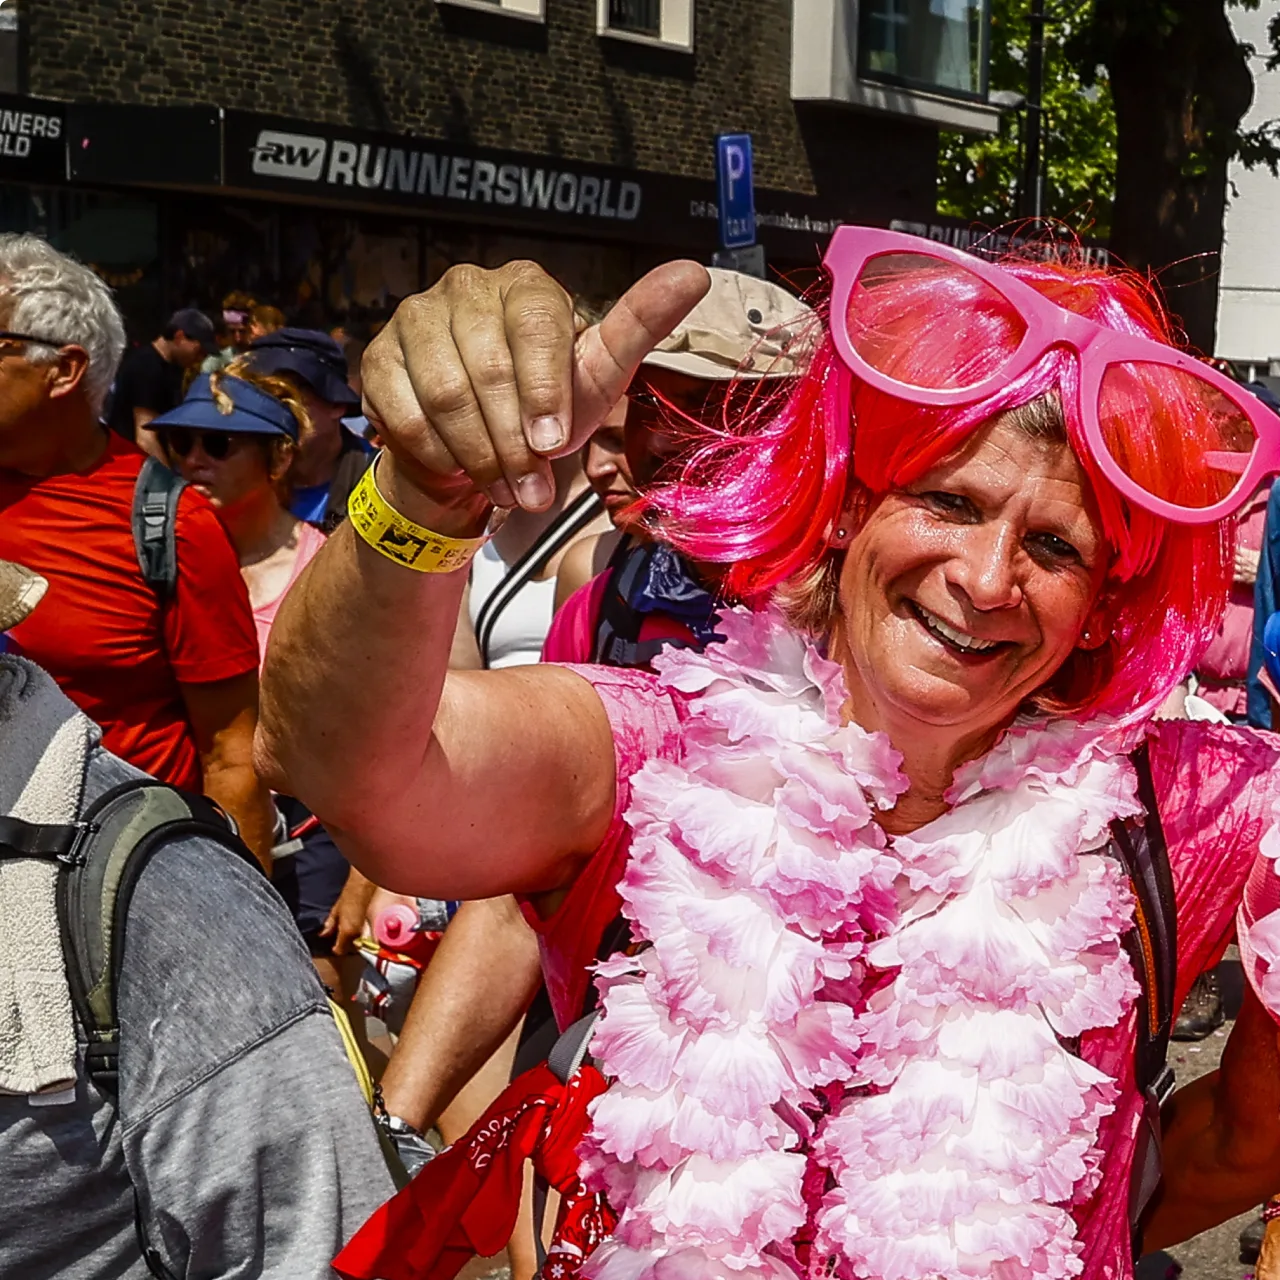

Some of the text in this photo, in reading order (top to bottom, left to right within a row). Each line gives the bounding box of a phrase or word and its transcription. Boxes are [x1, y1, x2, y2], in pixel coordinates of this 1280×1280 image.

[0, 109, 62, 138] NERS
[0, 134, 31, 157] LD
[326, 140, 642, 220] RUNNERSWORLD
[726, 144, 744, 200] P
